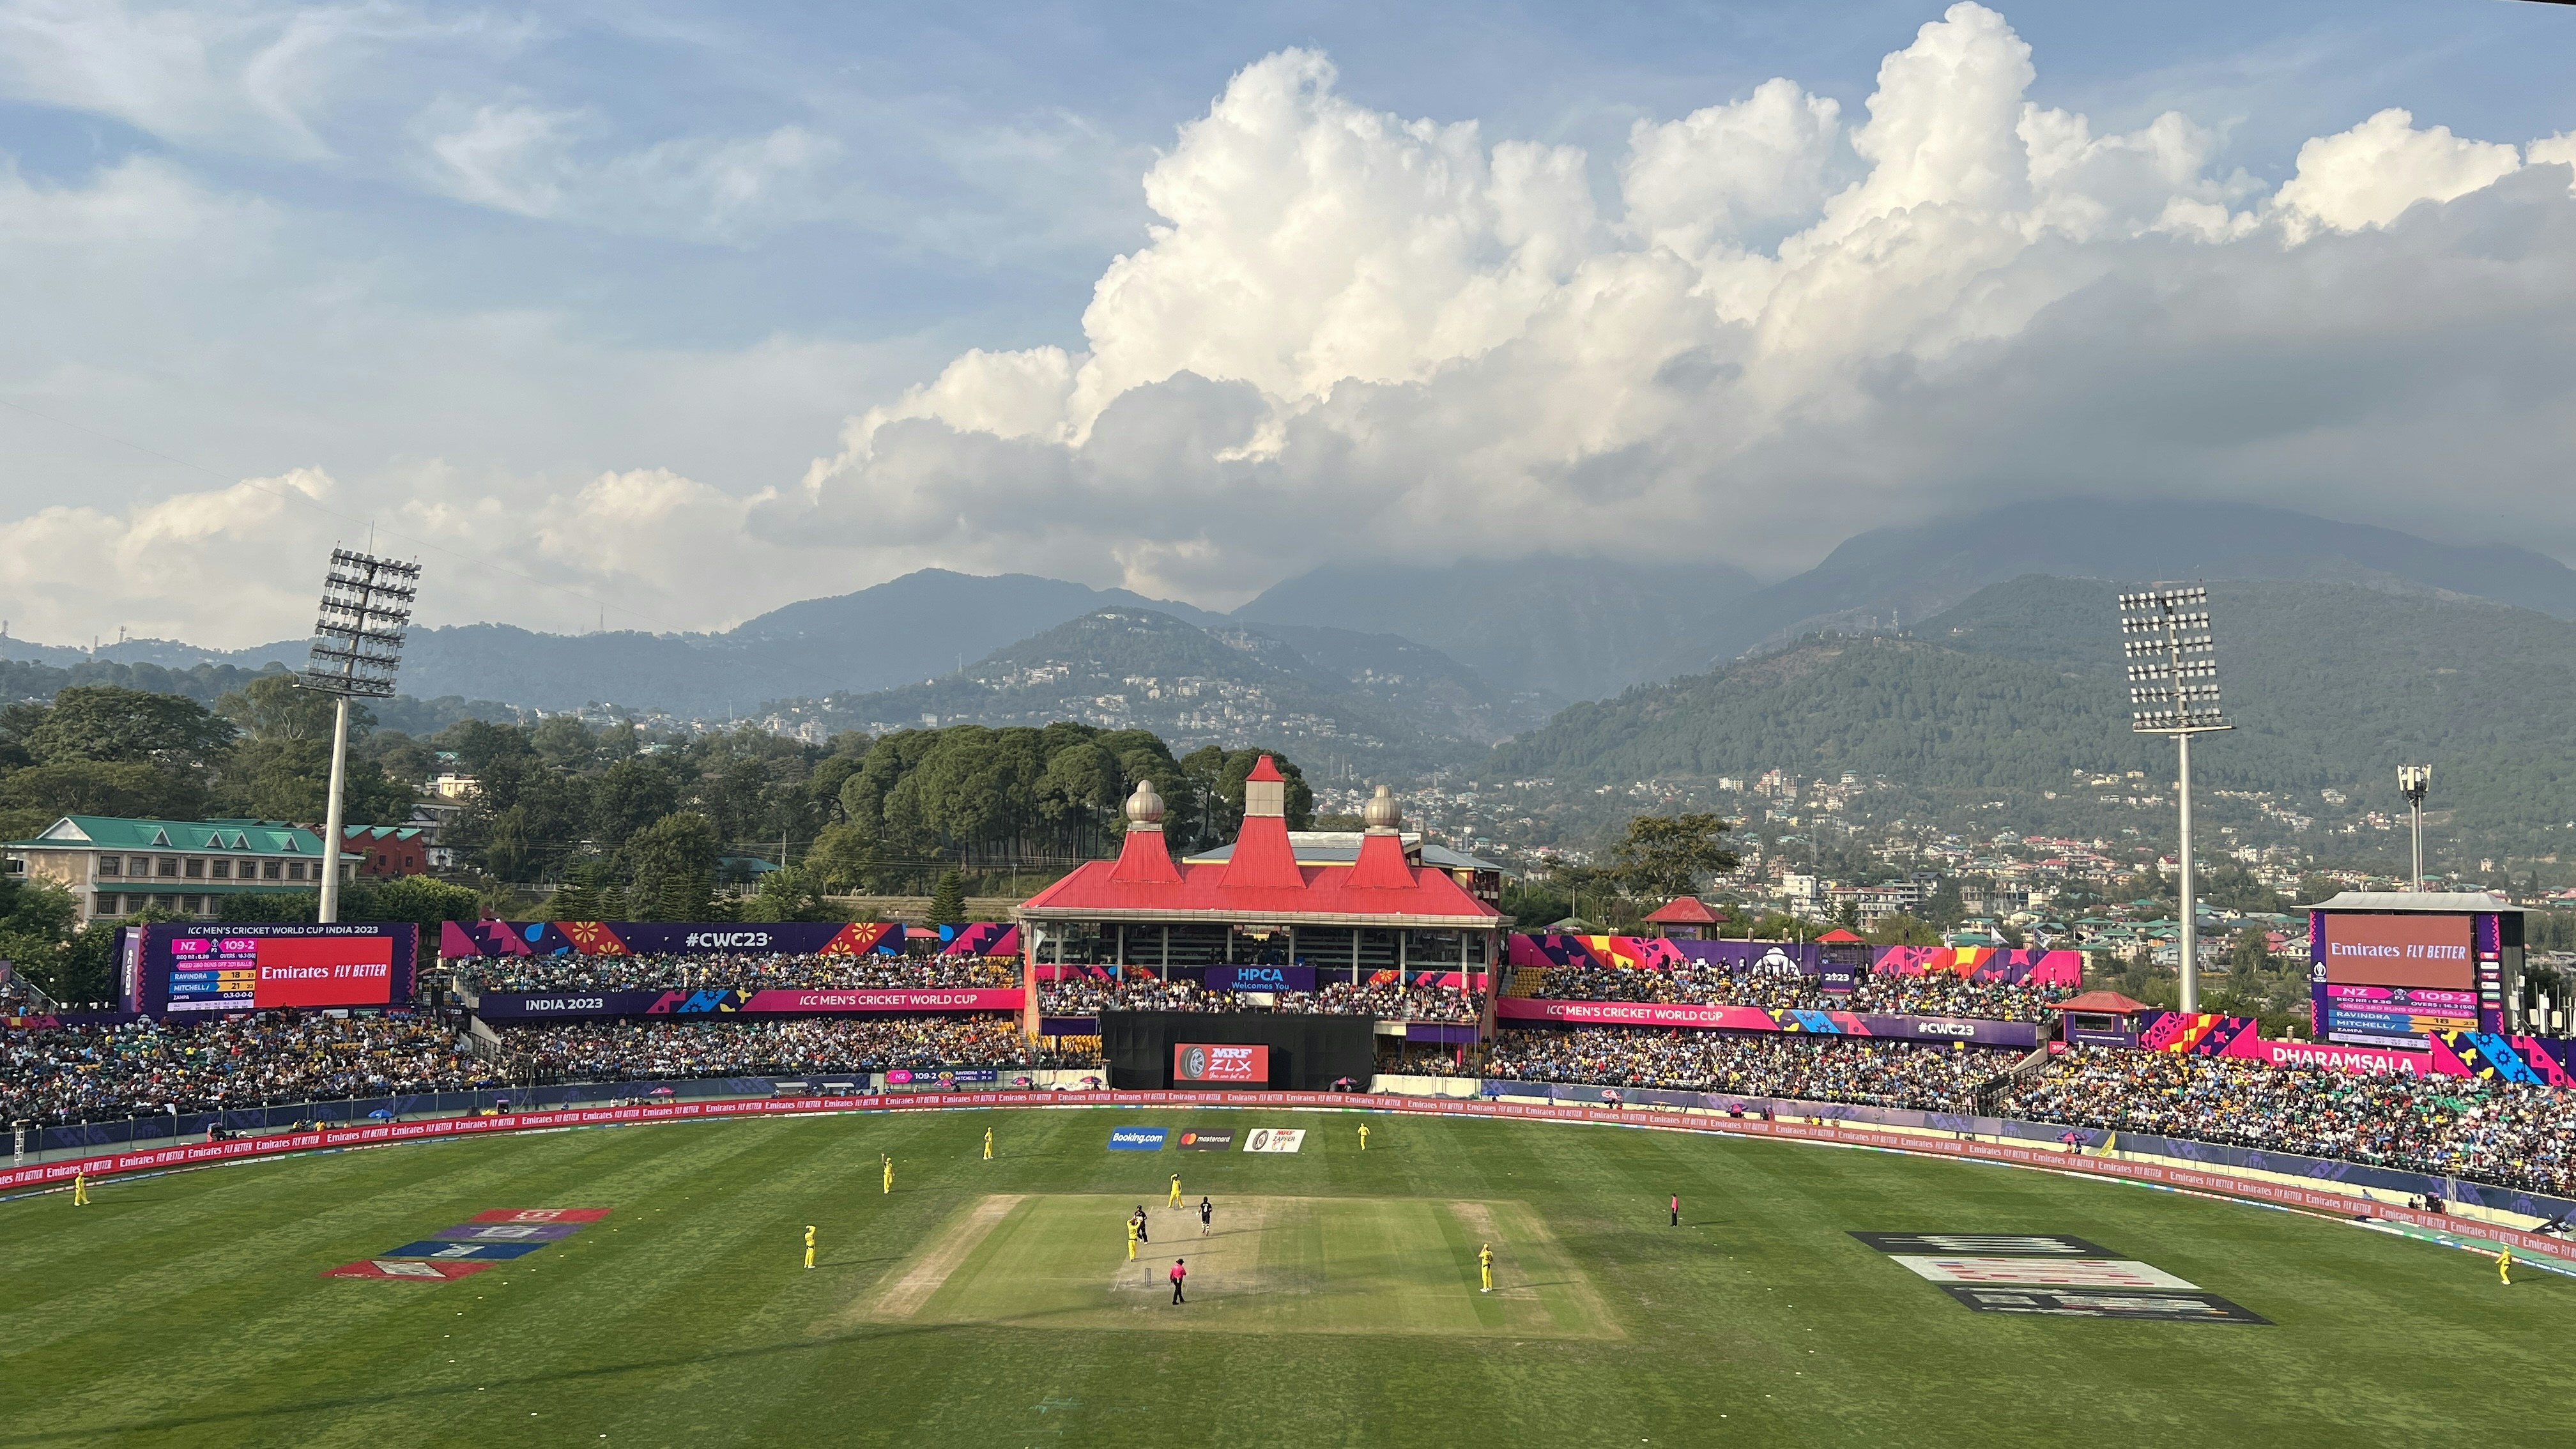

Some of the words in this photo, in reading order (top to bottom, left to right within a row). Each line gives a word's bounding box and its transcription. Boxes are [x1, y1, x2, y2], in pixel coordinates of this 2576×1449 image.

[224, 940, 255, 950] 109-2
[686, 932, 767, 947] #CWC23
[180, 941, 196, 951] NZ
[2331, 942, 2400, 956] Emirates
[2406, 944, 2424, 958] FLY
[2427, 945, 2466, 959] BETTER
[261, 965, 328, 979] Emirates
[334, 965, 351, 977] FLY
[353, 963, 387, 977] BETTER
[1238, 968, 1284, 981] HPCA
[2342, 987, 2368, 996] NZ
[2418, 992, 2472, 1002] 109-2
[526, 999, 565, 1010] INDIA
[567, 998, 603, 1009] 2023
[800, 995, 818, 1005] ICC
[820, 995, 855, 1005] MEN'S
[858, 995, 907, 1005] CRICKET
[910, 995, 952, 1004] WORLD
[953, 994, 977, 1004] CUP
[1546, 1005, 1565, 1015] ICC
[1566, 1007, 1600, 1016] MEN'S
[1602, 1008, 1652, 1018] CRICKET
[1655, 1009, 1697, 1020] WORLD
[1699, 1011, 1723, 1021] CUP
[2336, 1011, 2391, 1020] RAVINDRA
[1918, 1022, 1974, 1036] #CWC23
[2336, 1020, 2389, 1029] MITCHELL
[1211, 1048, 1252, 1059] MRF
[2272, 1046, 2414, 1071] DHARAMSALA
[1208, 1059, 1252, 1071] ZLX
[1169, 1092, 1196, 1101] Emirates
[683, 1105, 698, 1114] BETTER
[1408, 1100, 1437, 1109] Emirates
[1447, 1102, 1463, 1110] BETTER
[523, 1116, 552, 1124] Emirates
[563, 1113, 579, 1122] BETTER
[1590, 1111, 1619, 1119] Emirates
[1711, 1119, 1740, 1129] Emirates
[1752, 1123, 1768, 1131] BETTER
[328, 1133, 359, 1142] Emirates
[362, 1130, 371, 1138] FLY
[371, 1128, 388, 1138] BETTER
[1112, 1132, 1163, 1144] Booking.com
[1839, 1131, 1869, 1142] Emirates
[1880, 1135, 1897, 1144] BETTER
[188, 1147, 222, 1158] Emirates
[224, 1144, 234, 1154] FLY
[234, 1142, 252, 1153] BETTER
[1969, 1145, 2001, 1156] Emirates
[2004, 1149, 2012, 1157] FLY
[2012, 1150, 2029, 1160] BETTER
[47, 1166, 80, 1177] Emirates
[83, 1162, 92, 1172] FLY
[92, 1160, 112, 1170] BETTER
[2170, 1171, 2203, 1184] Emirates
[2206, 1177, 2215, 1186] FLY
[2216, 1179, 2234, 1190] BETTER
[2306, 1194, 2340, 1208] Emirates
[2343, 1200, 2352, 1210] FLY
[2353, 1202, 2372, 1214] BETTER
[2451, 1222, 2486, 1238] Emirates
[2490, 1229, 2499, 1240] FLY
[2499, 1232, 2518, 1246] BETTER
